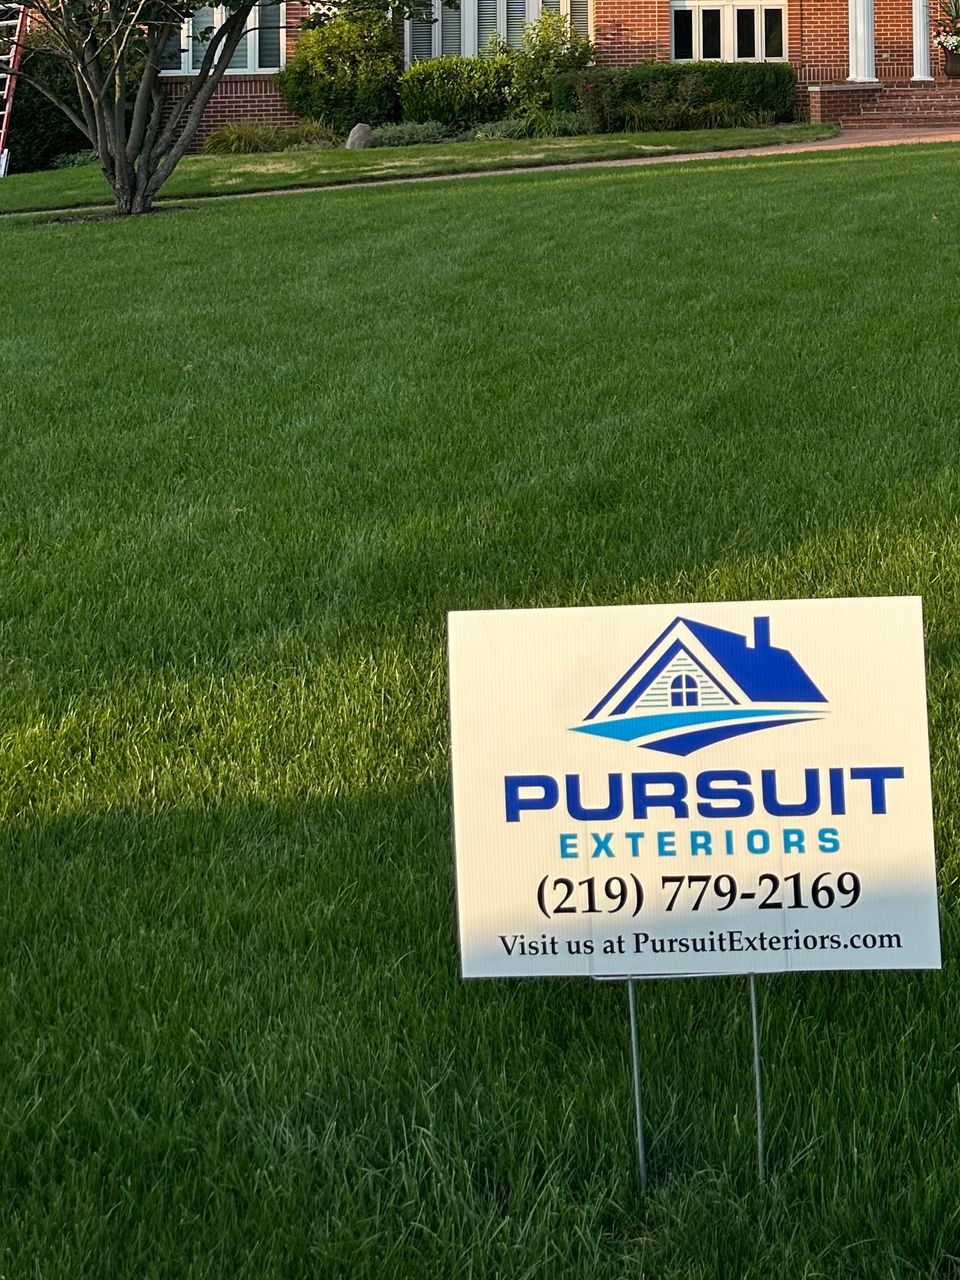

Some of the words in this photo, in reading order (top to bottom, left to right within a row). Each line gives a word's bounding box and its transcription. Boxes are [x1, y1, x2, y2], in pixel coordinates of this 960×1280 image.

[503, 766, 905, 823] PURSUIT
[559, 827, 842, 859] EXTERIORS
[536, 872, 645, 919] (219)
[660, 871, 862, 913] 779-2169
[498, 933, 559, 957] Visit
[566, 938, 595, 955] us
[602, 934, 626, 955] at
[632, 928, 903, 954] PursuitExteriors.com
